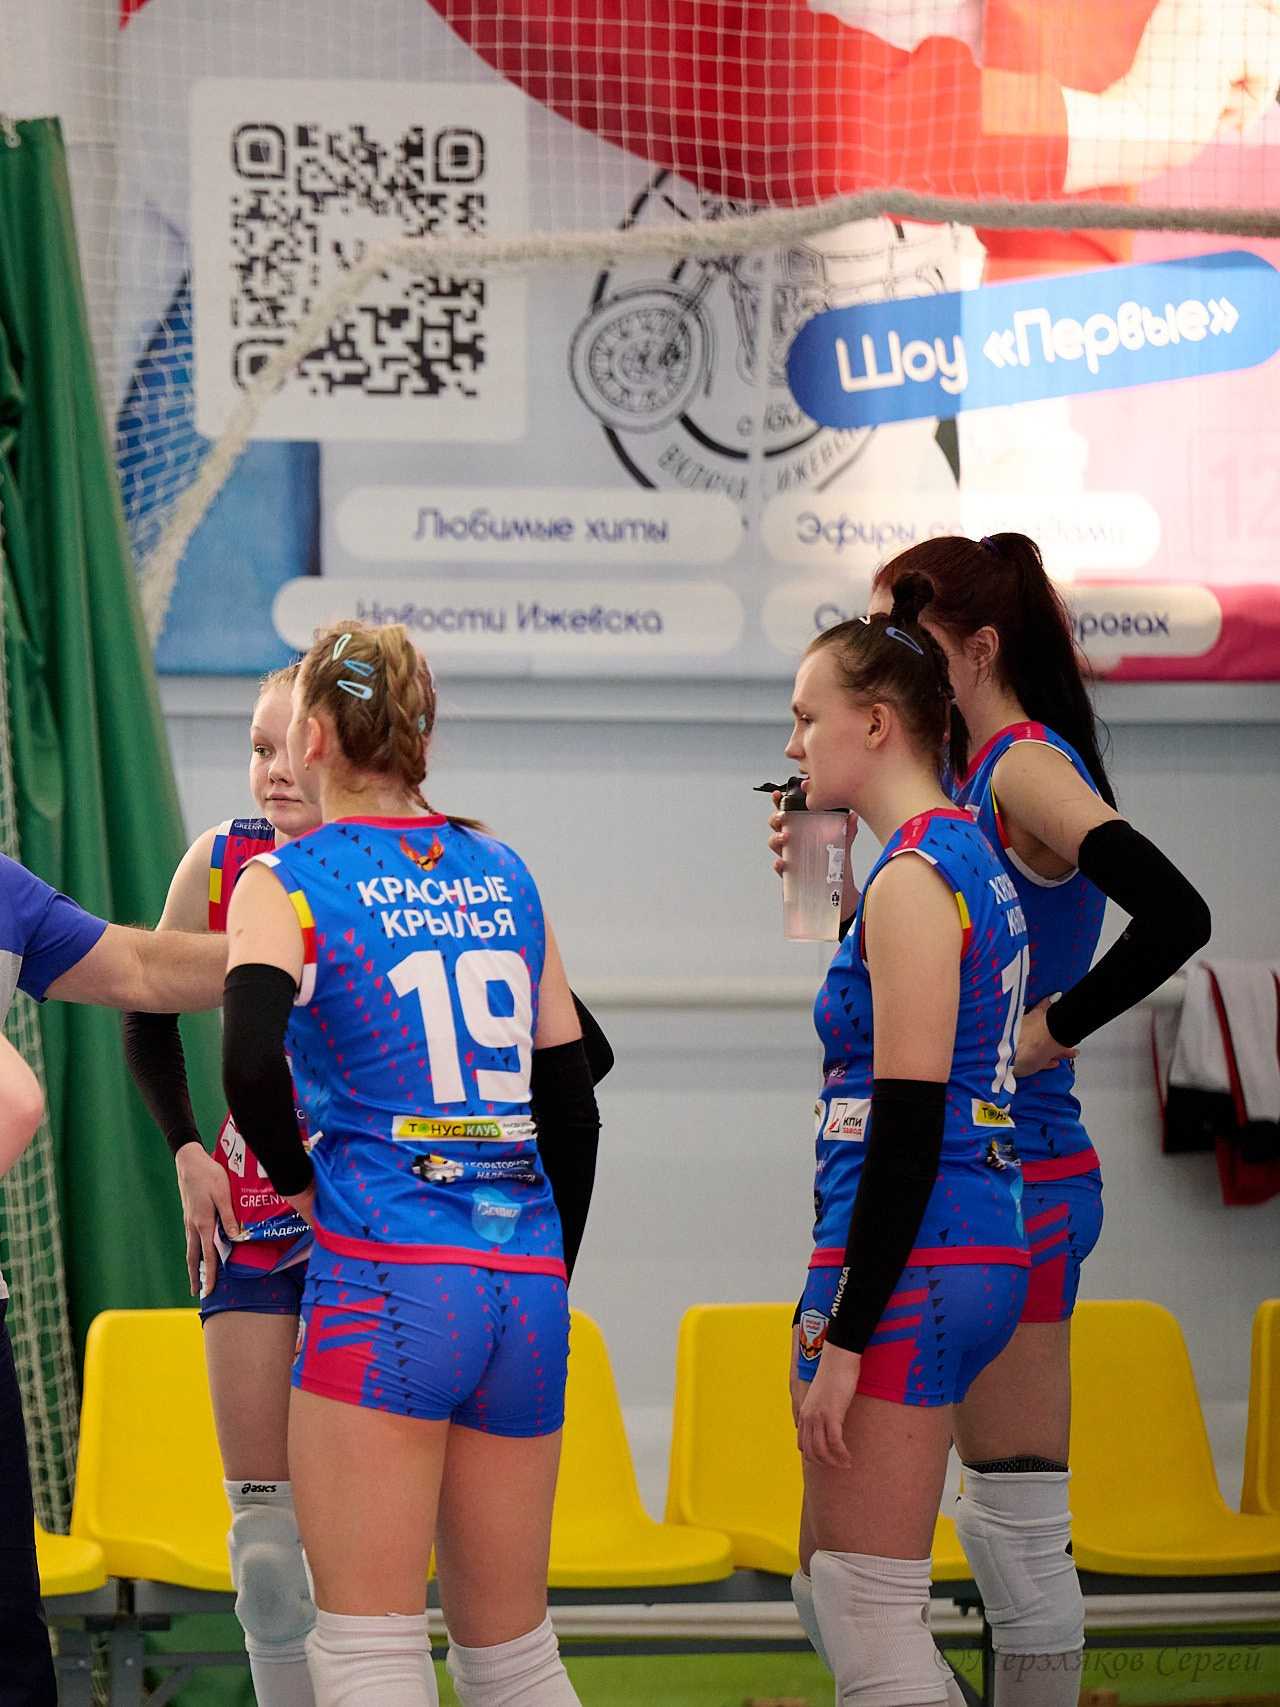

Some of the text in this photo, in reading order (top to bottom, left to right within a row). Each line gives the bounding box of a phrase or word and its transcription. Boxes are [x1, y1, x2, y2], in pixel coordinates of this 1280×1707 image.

[835, 297, 1239, 395] Шоу «Первые»
[413, 508, 669, 544] Любимые хиты
[796, 512, 916, 549] Эфиры
[356, 601, 663, 634] Новости Ижевска
[357, 876, 514, 907] КРАСНЫЕ
[380, 908, 517, 939] КРЫЛЬЯ
[386, 949, 533, 1105] 19
[465, 1123, 499, 1137] КЛУБ
[843, 1117, 863, 1127] КПИ
[830, 1266, 851, 1318] MIKASA
[250, 1484, 277, 1493] asics
